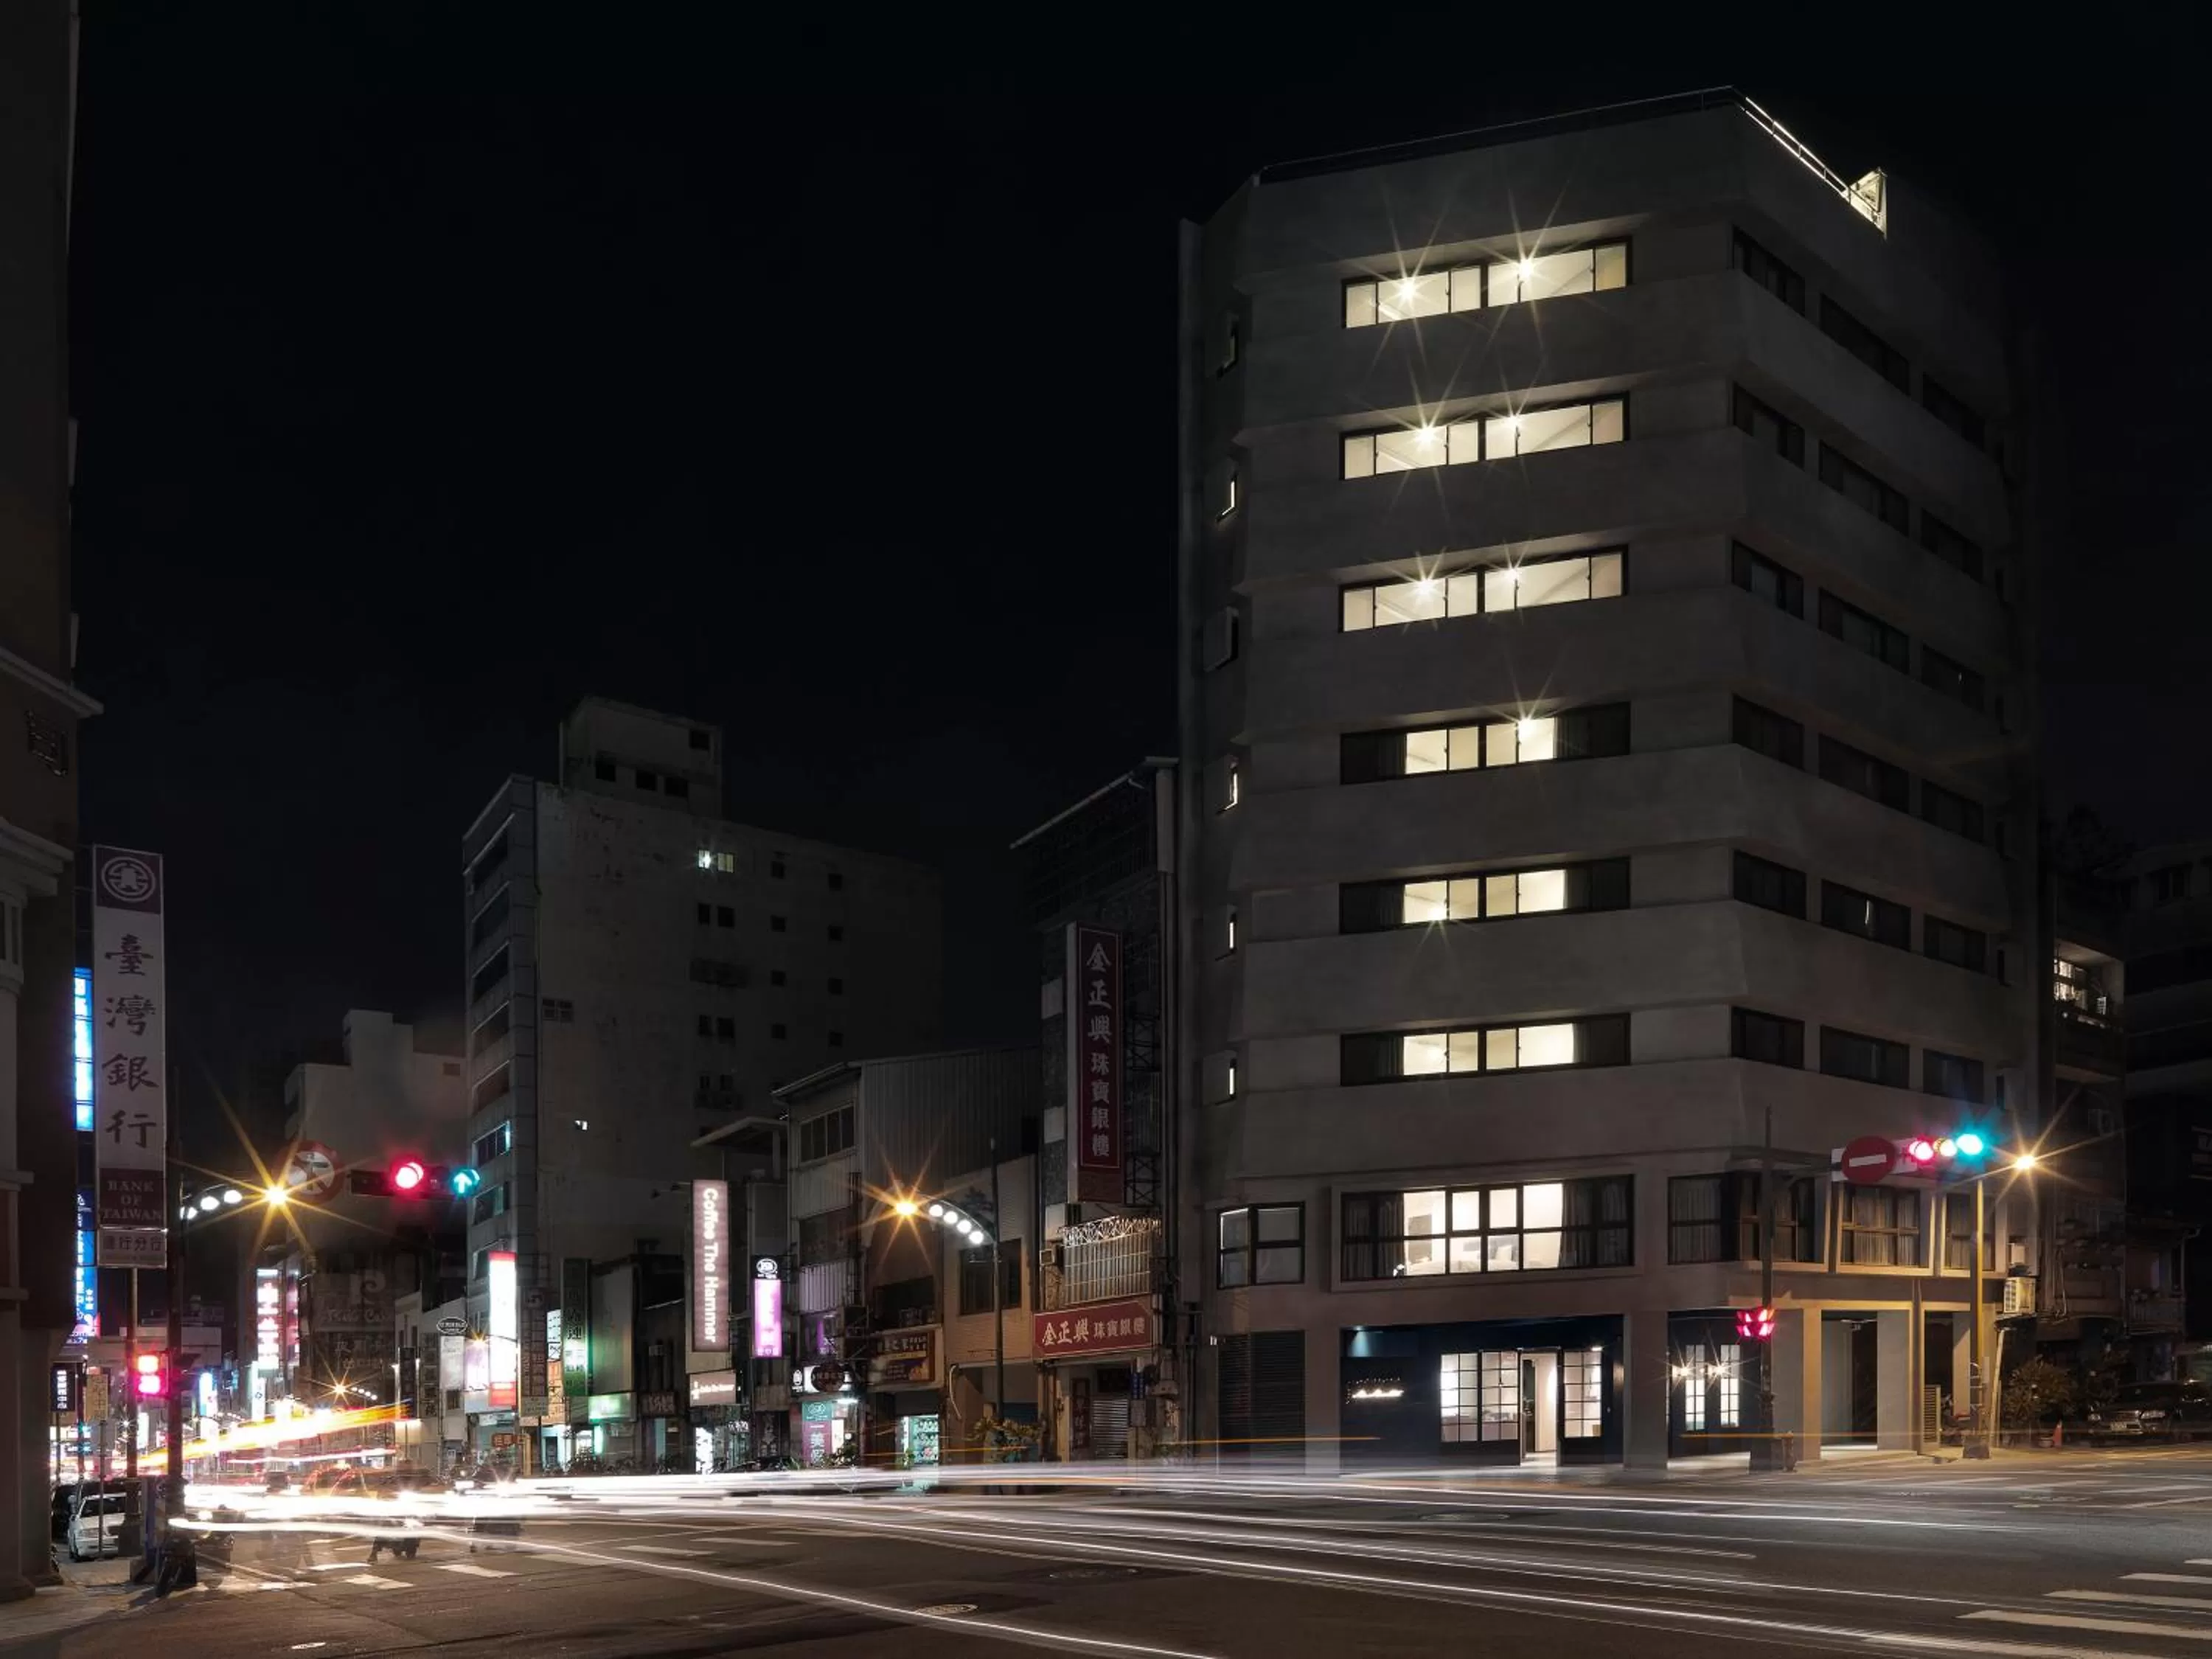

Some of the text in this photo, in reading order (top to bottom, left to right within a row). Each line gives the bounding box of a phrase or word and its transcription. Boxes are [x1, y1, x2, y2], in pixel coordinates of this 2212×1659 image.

[102, 933, 158, 1148] 臺灣銀行
[107, 1180, 154, 1192] BANK
[120, 1194, 142, 1207] OF
[102, 1207, 163, 1222] TAIWAN
[703, 1188, 719, 1343] Coffee The Hammer
